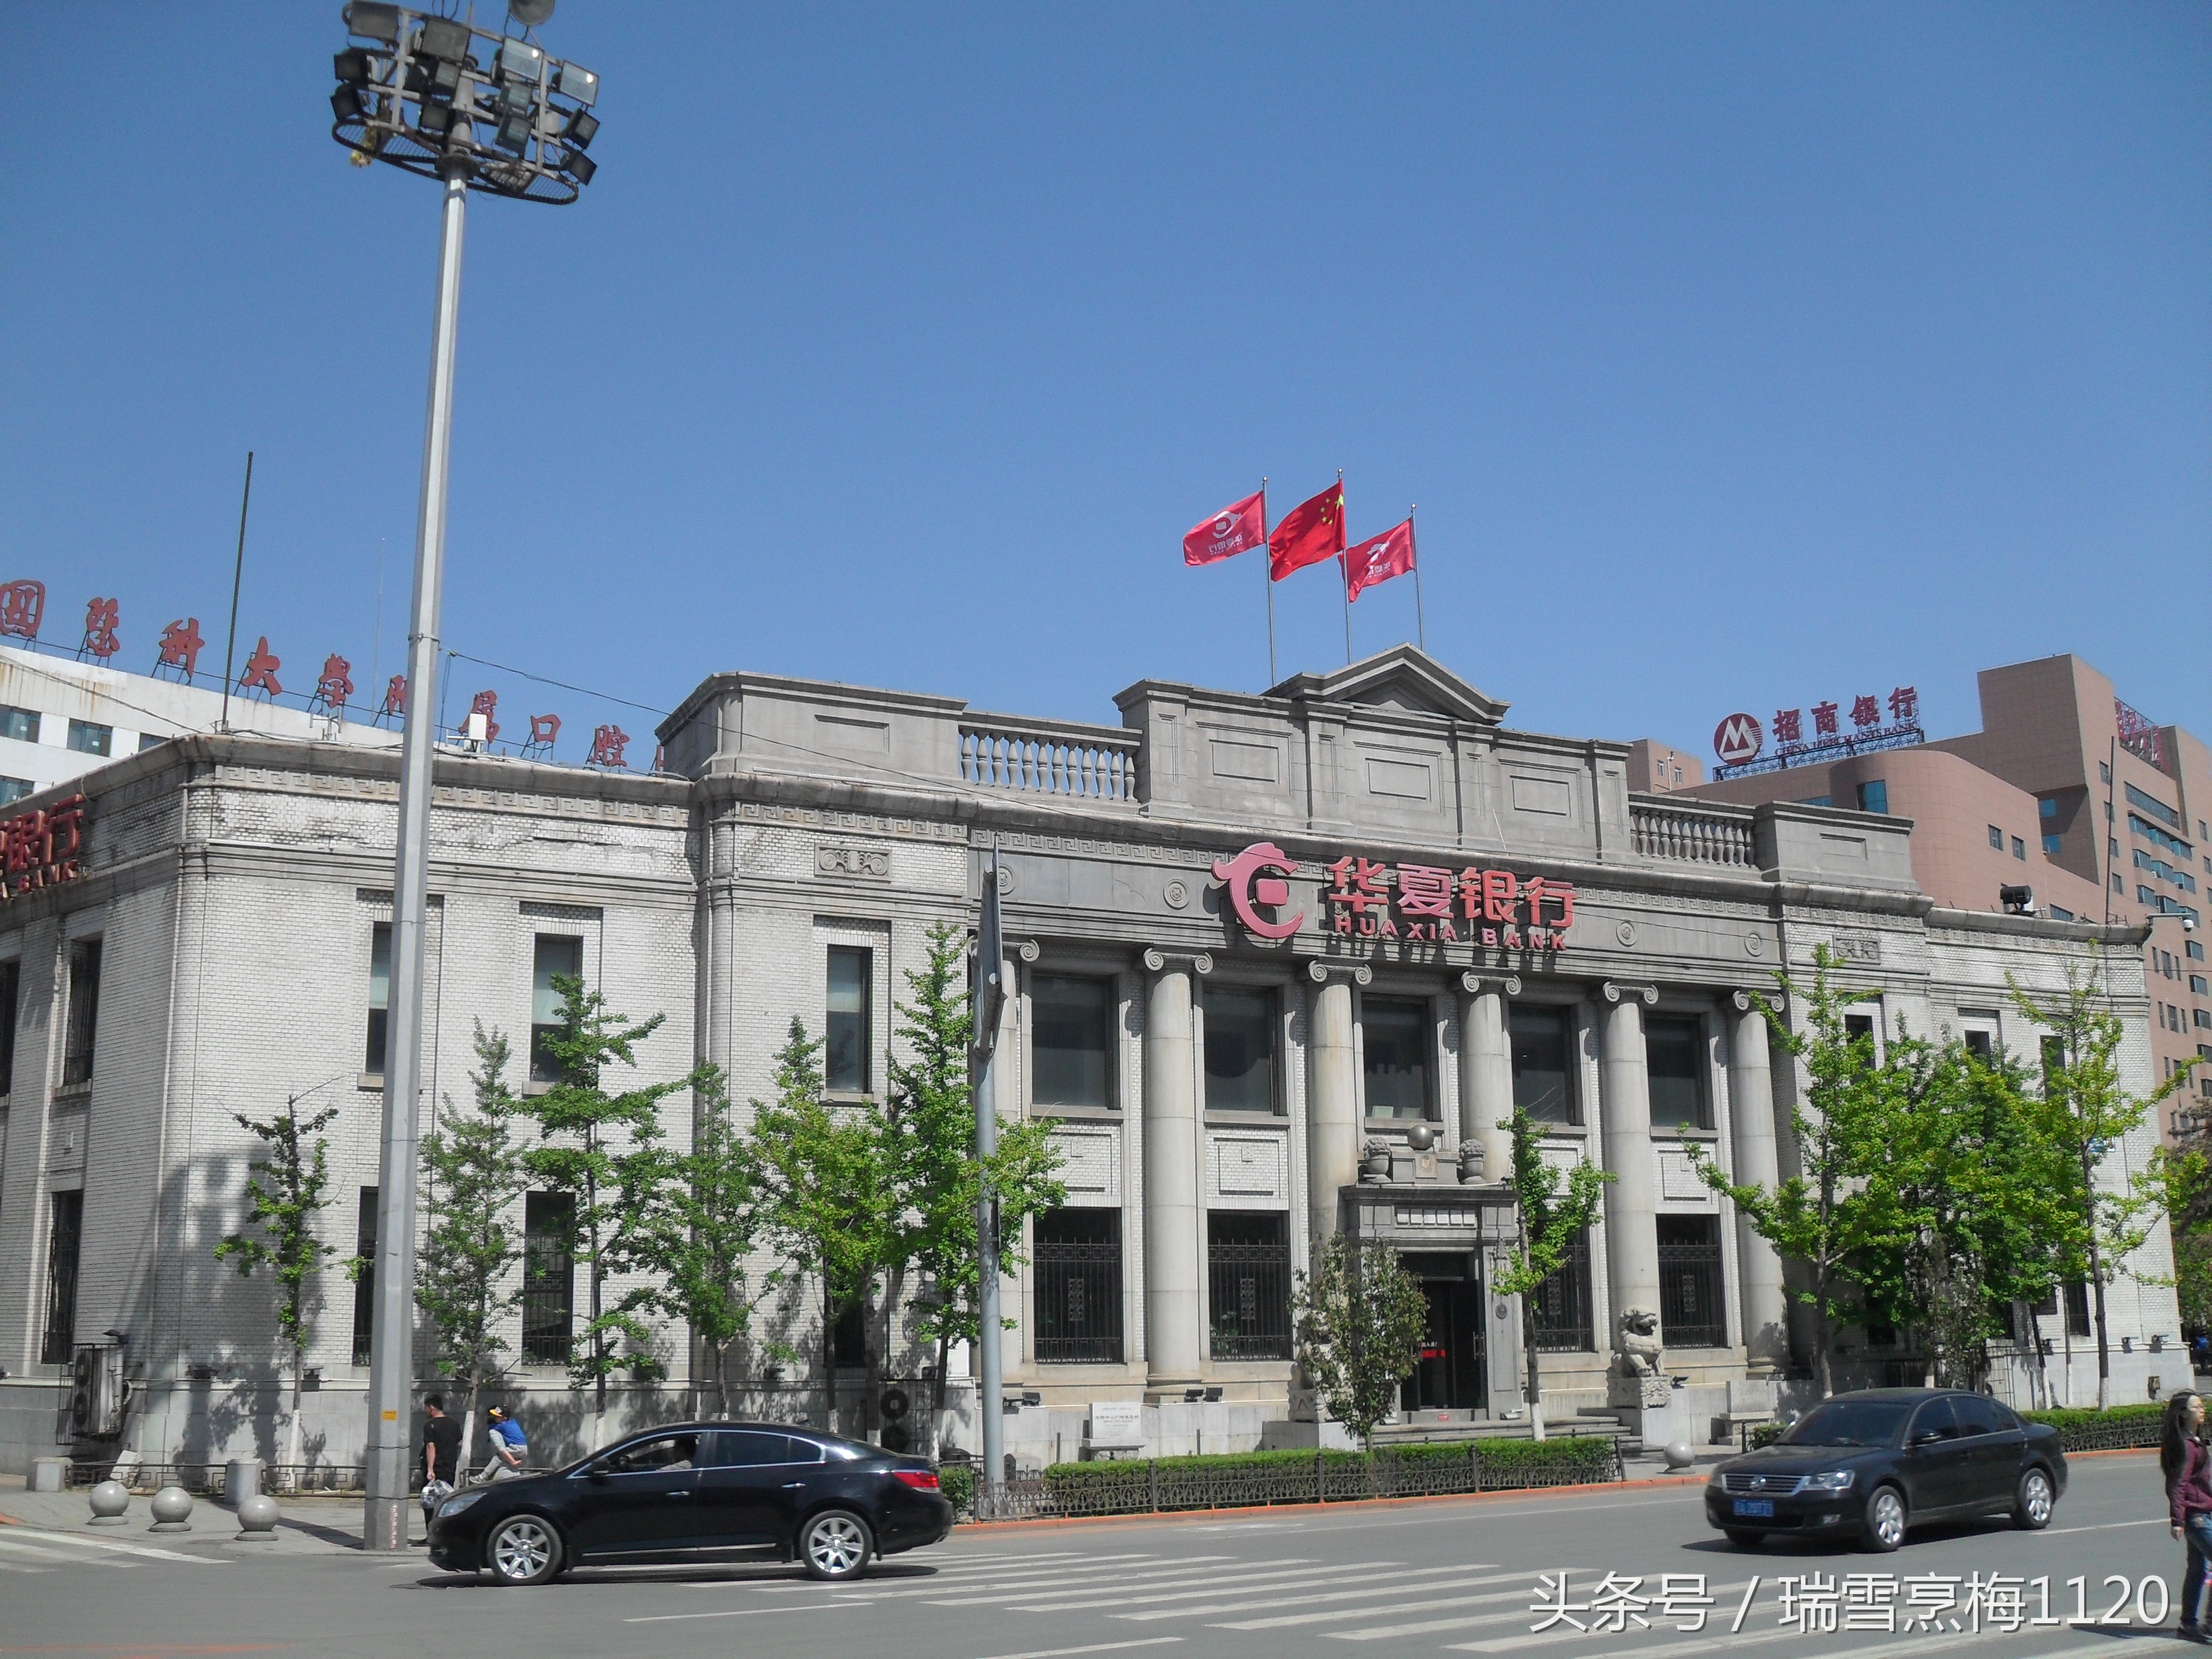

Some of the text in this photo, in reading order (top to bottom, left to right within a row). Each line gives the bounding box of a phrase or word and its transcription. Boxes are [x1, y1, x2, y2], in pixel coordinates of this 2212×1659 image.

[18, 859, 79, 894] BANK
[1327, 855, 1578, 928] 华夏银行
[1336, 916, 1567, 951] HUA XIA BANK
